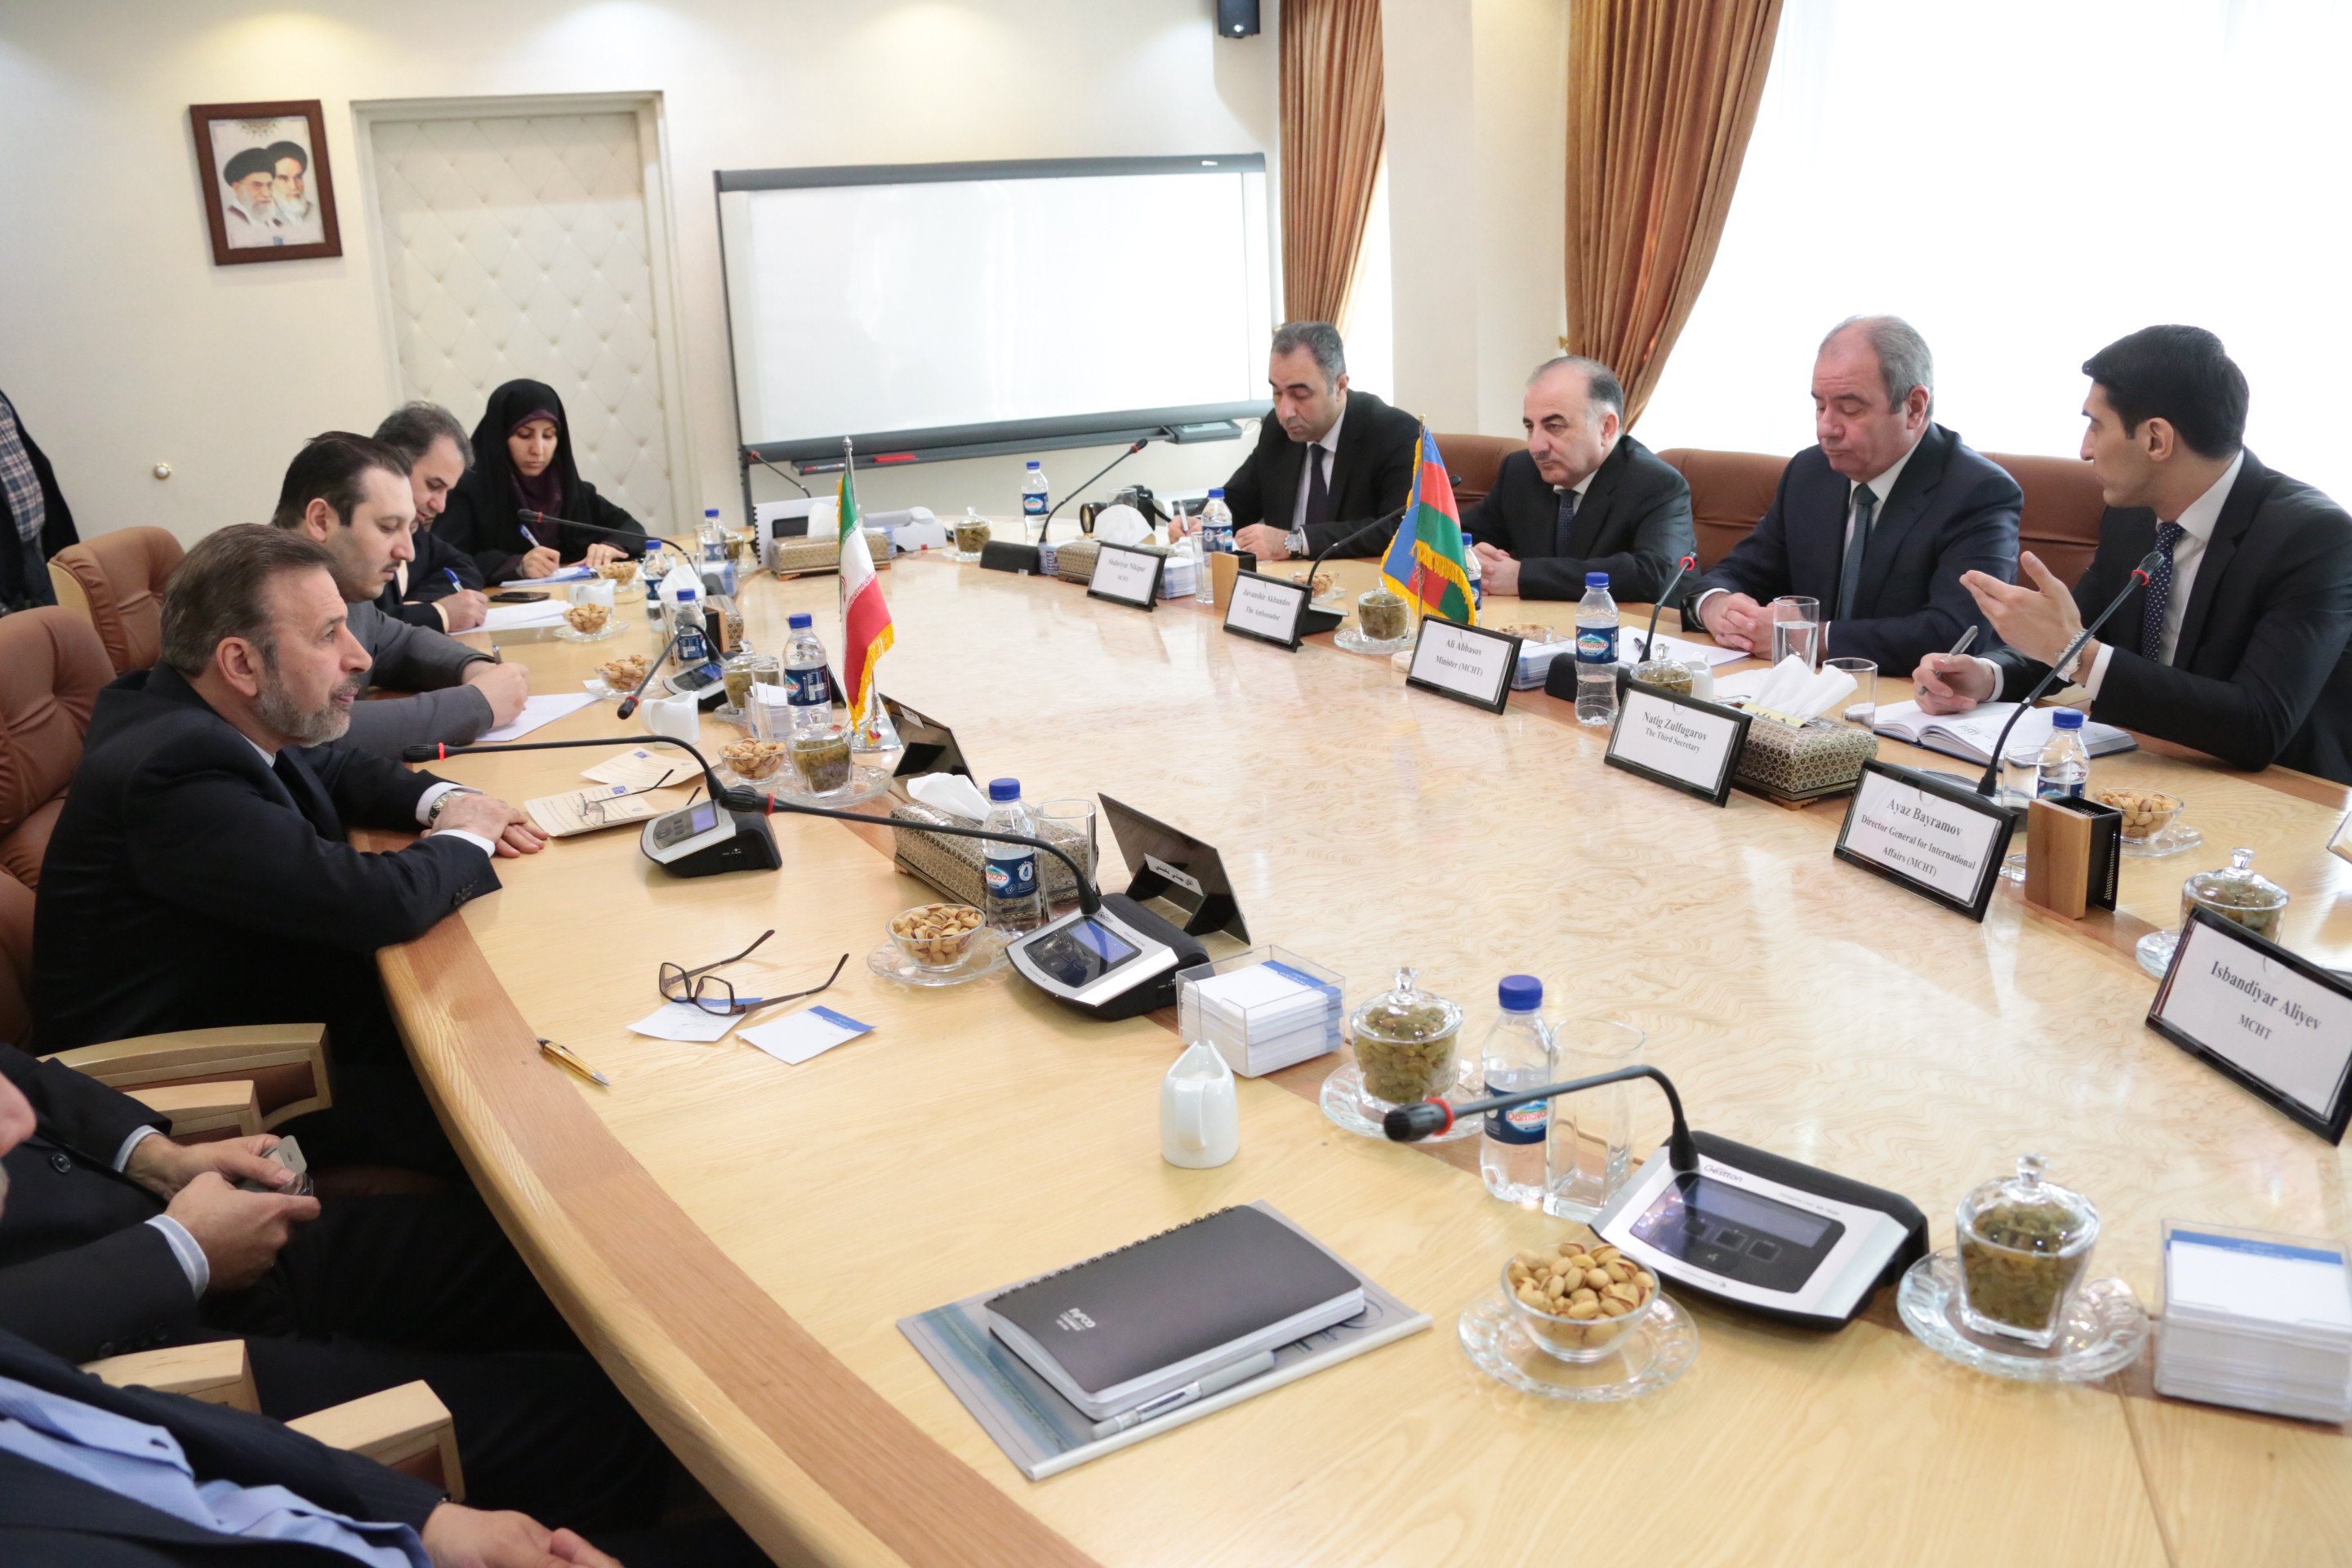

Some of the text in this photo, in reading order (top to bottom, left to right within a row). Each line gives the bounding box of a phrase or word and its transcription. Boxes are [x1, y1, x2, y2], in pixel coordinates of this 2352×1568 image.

[1243, 589, 1266, 600] Javanshir
[1255, 608, 1280, 621] Ambassador
[1446, 639, 1482, 655] Ali Abbasov
[1436, 655, 1483, 676] Minister (MCHT)
[1642, 711, 1708, 742] Natig Zulfugarov
[1646, 728, 1700, 754] The Third Secretary
[1886, 799, 1962, 836] Ayaz Bayramov
[1861, 814, 1976, 870] Director General for International
[1882, 846, 1937, 877] Affairs (MCHT)
[2211, 960, 2322, 1031] Isbandiyar Aliyev
[2238, 1014, 2273, 1040] MCHT
[1704, 1164, 1743, 1183] Gestton
